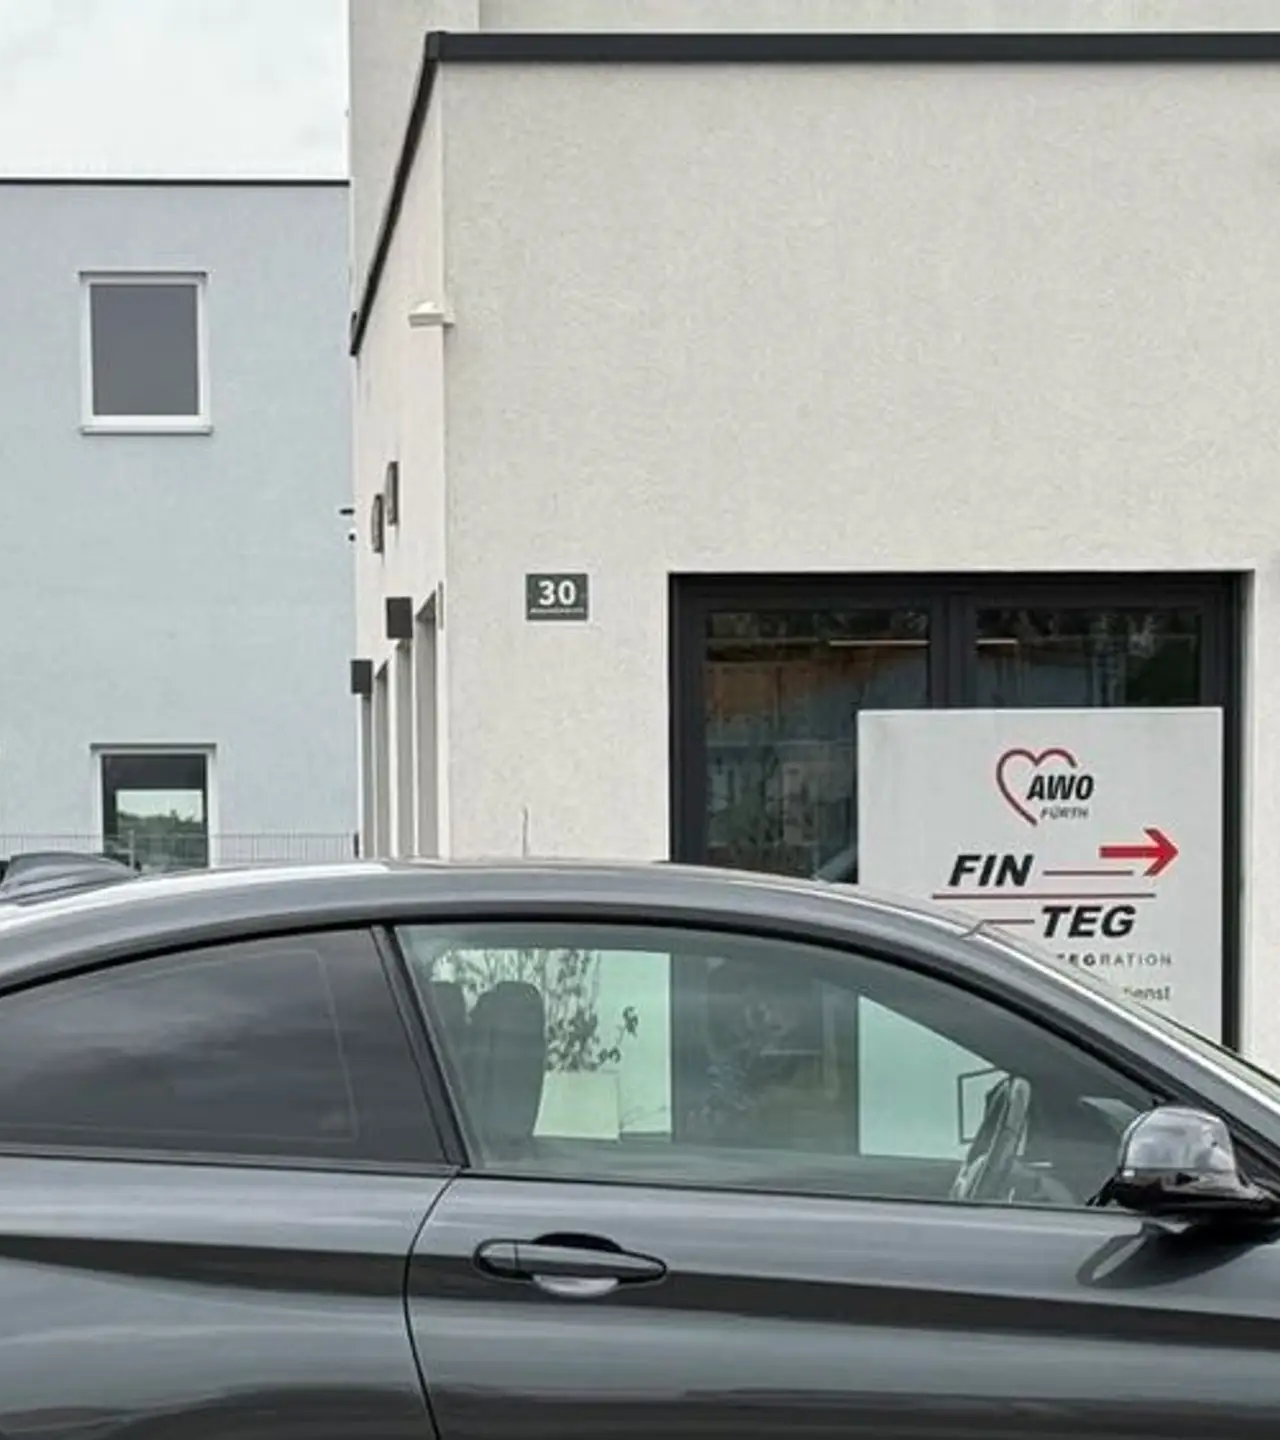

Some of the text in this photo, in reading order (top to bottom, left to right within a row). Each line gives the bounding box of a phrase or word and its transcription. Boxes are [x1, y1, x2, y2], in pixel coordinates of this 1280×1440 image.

[538, 579, 577, 606] 30
[1026, 774, 1094, 801] AWO
[948, 854, 1034, 887] FIN
[1042, 905, 1136, 938] TEG
